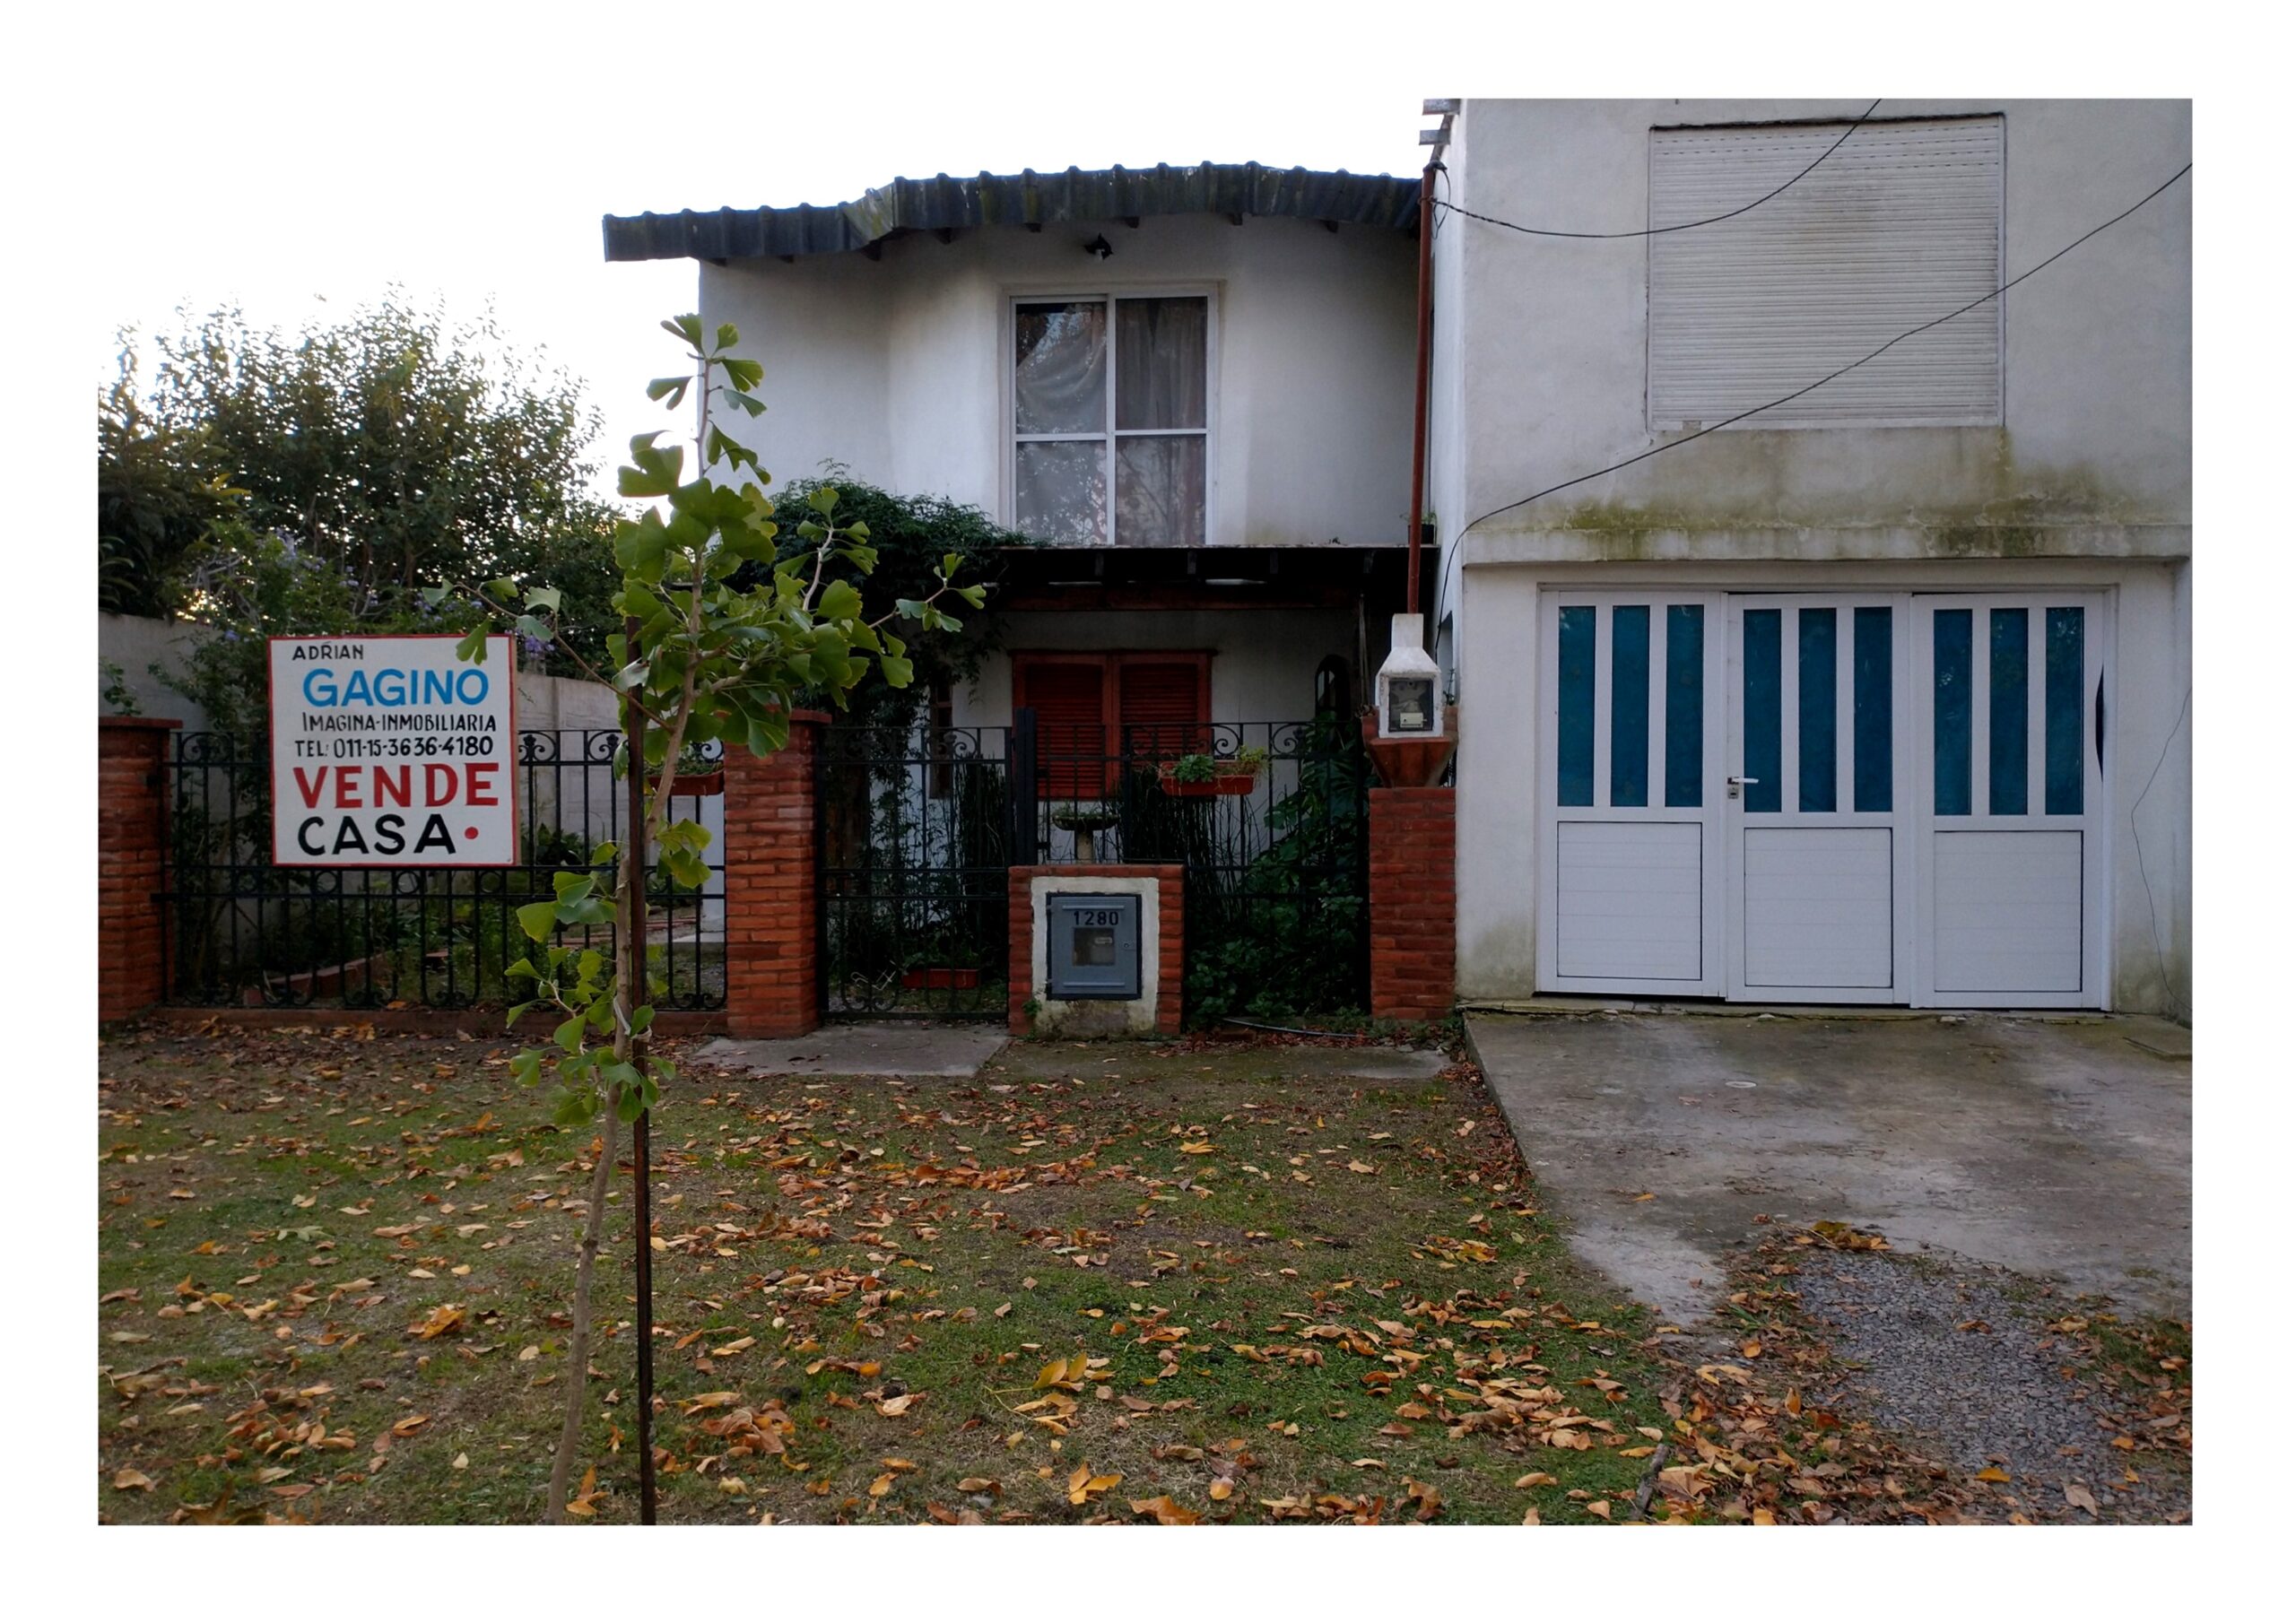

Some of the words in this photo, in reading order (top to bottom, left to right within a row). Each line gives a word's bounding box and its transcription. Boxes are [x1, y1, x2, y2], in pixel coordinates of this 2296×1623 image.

[302, 668, 489, 707] GAGINO
[292, 762, 500, 809] VENDE
[1074, 911, 1119, 925] 1280
